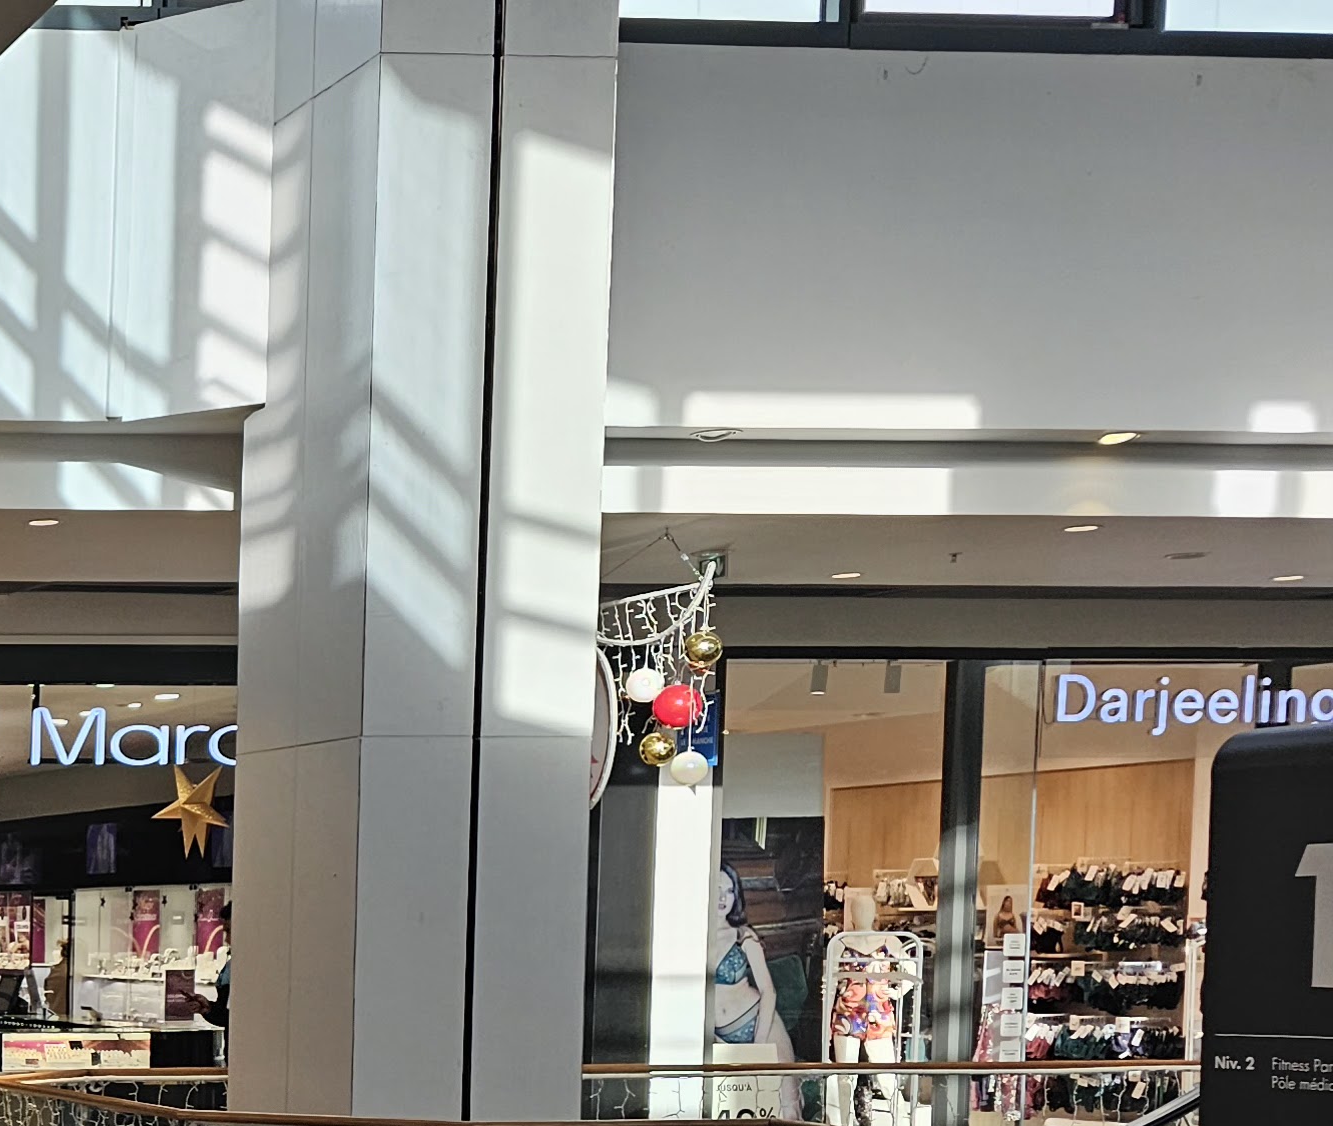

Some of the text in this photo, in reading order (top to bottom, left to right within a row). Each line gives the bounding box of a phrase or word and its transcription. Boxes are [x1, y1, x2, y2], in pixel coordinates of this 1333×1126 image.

[1295, 843, 1333, 988] 1
[1214, 1055, 1256, 1071] Niv. 2
[1271, 1056, 1333, 1073] Fitness Par
[1271, 1074, 1333, 1092] Pôle médic
